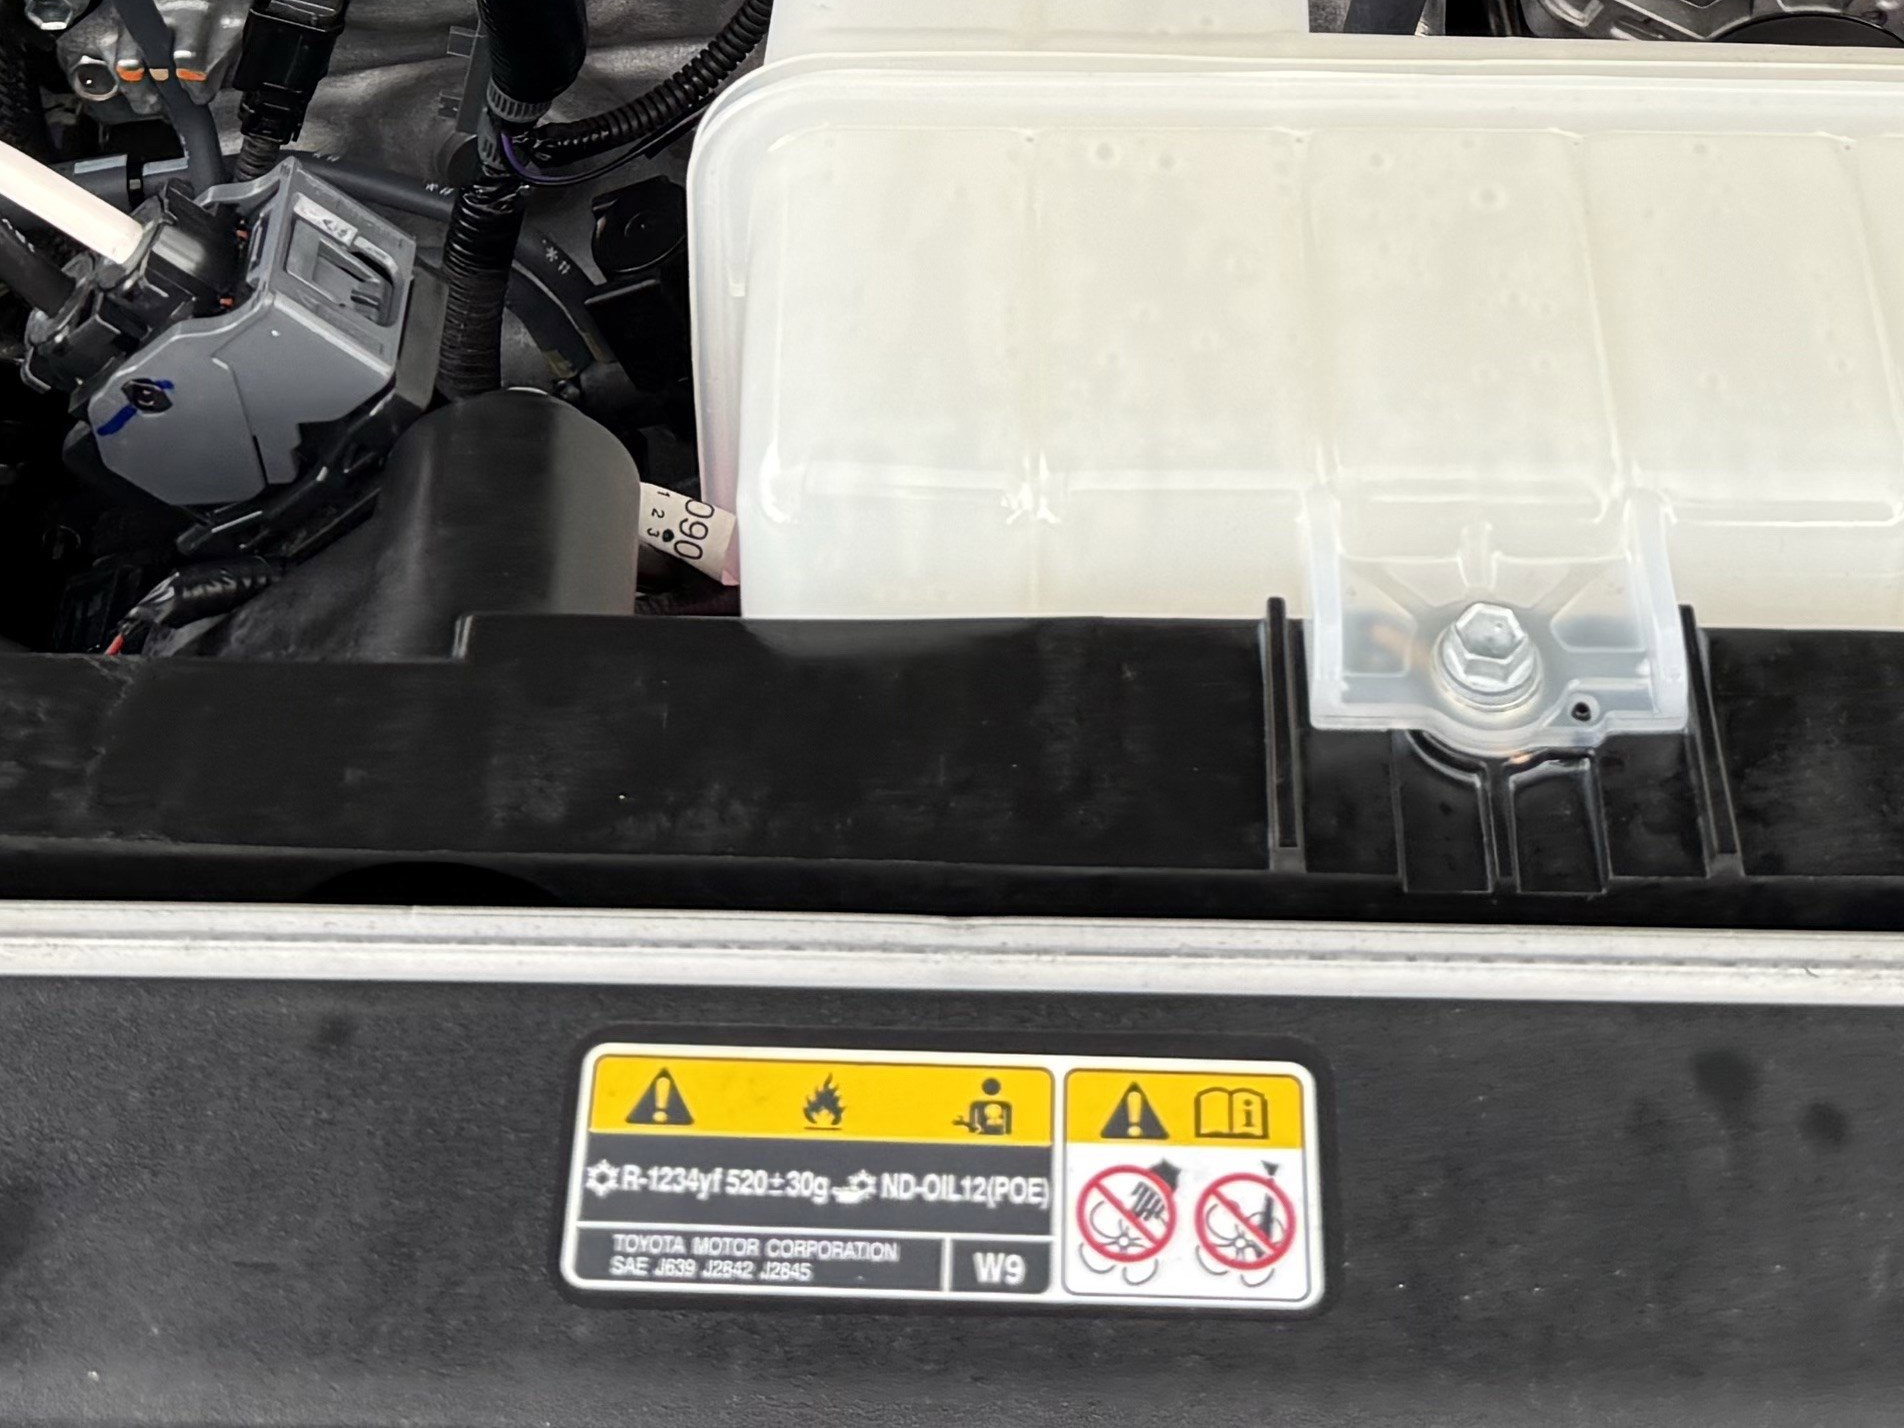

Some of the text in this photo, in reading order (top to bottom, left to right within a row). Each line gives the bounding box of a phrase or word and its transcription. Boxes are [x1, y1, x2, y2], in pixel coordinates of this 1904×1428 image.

[673, 498, 716, 561] 090
[620, 1162, 1052, 1211] R-1234yf 520±30g ND-OIL12(POE)
[613, 1233, 900, 1262] TOYOTA MOTOR CORPORATION
[611, 1256, 649, 1278] SAE
[973, 1251, 1026, 1286] W9
